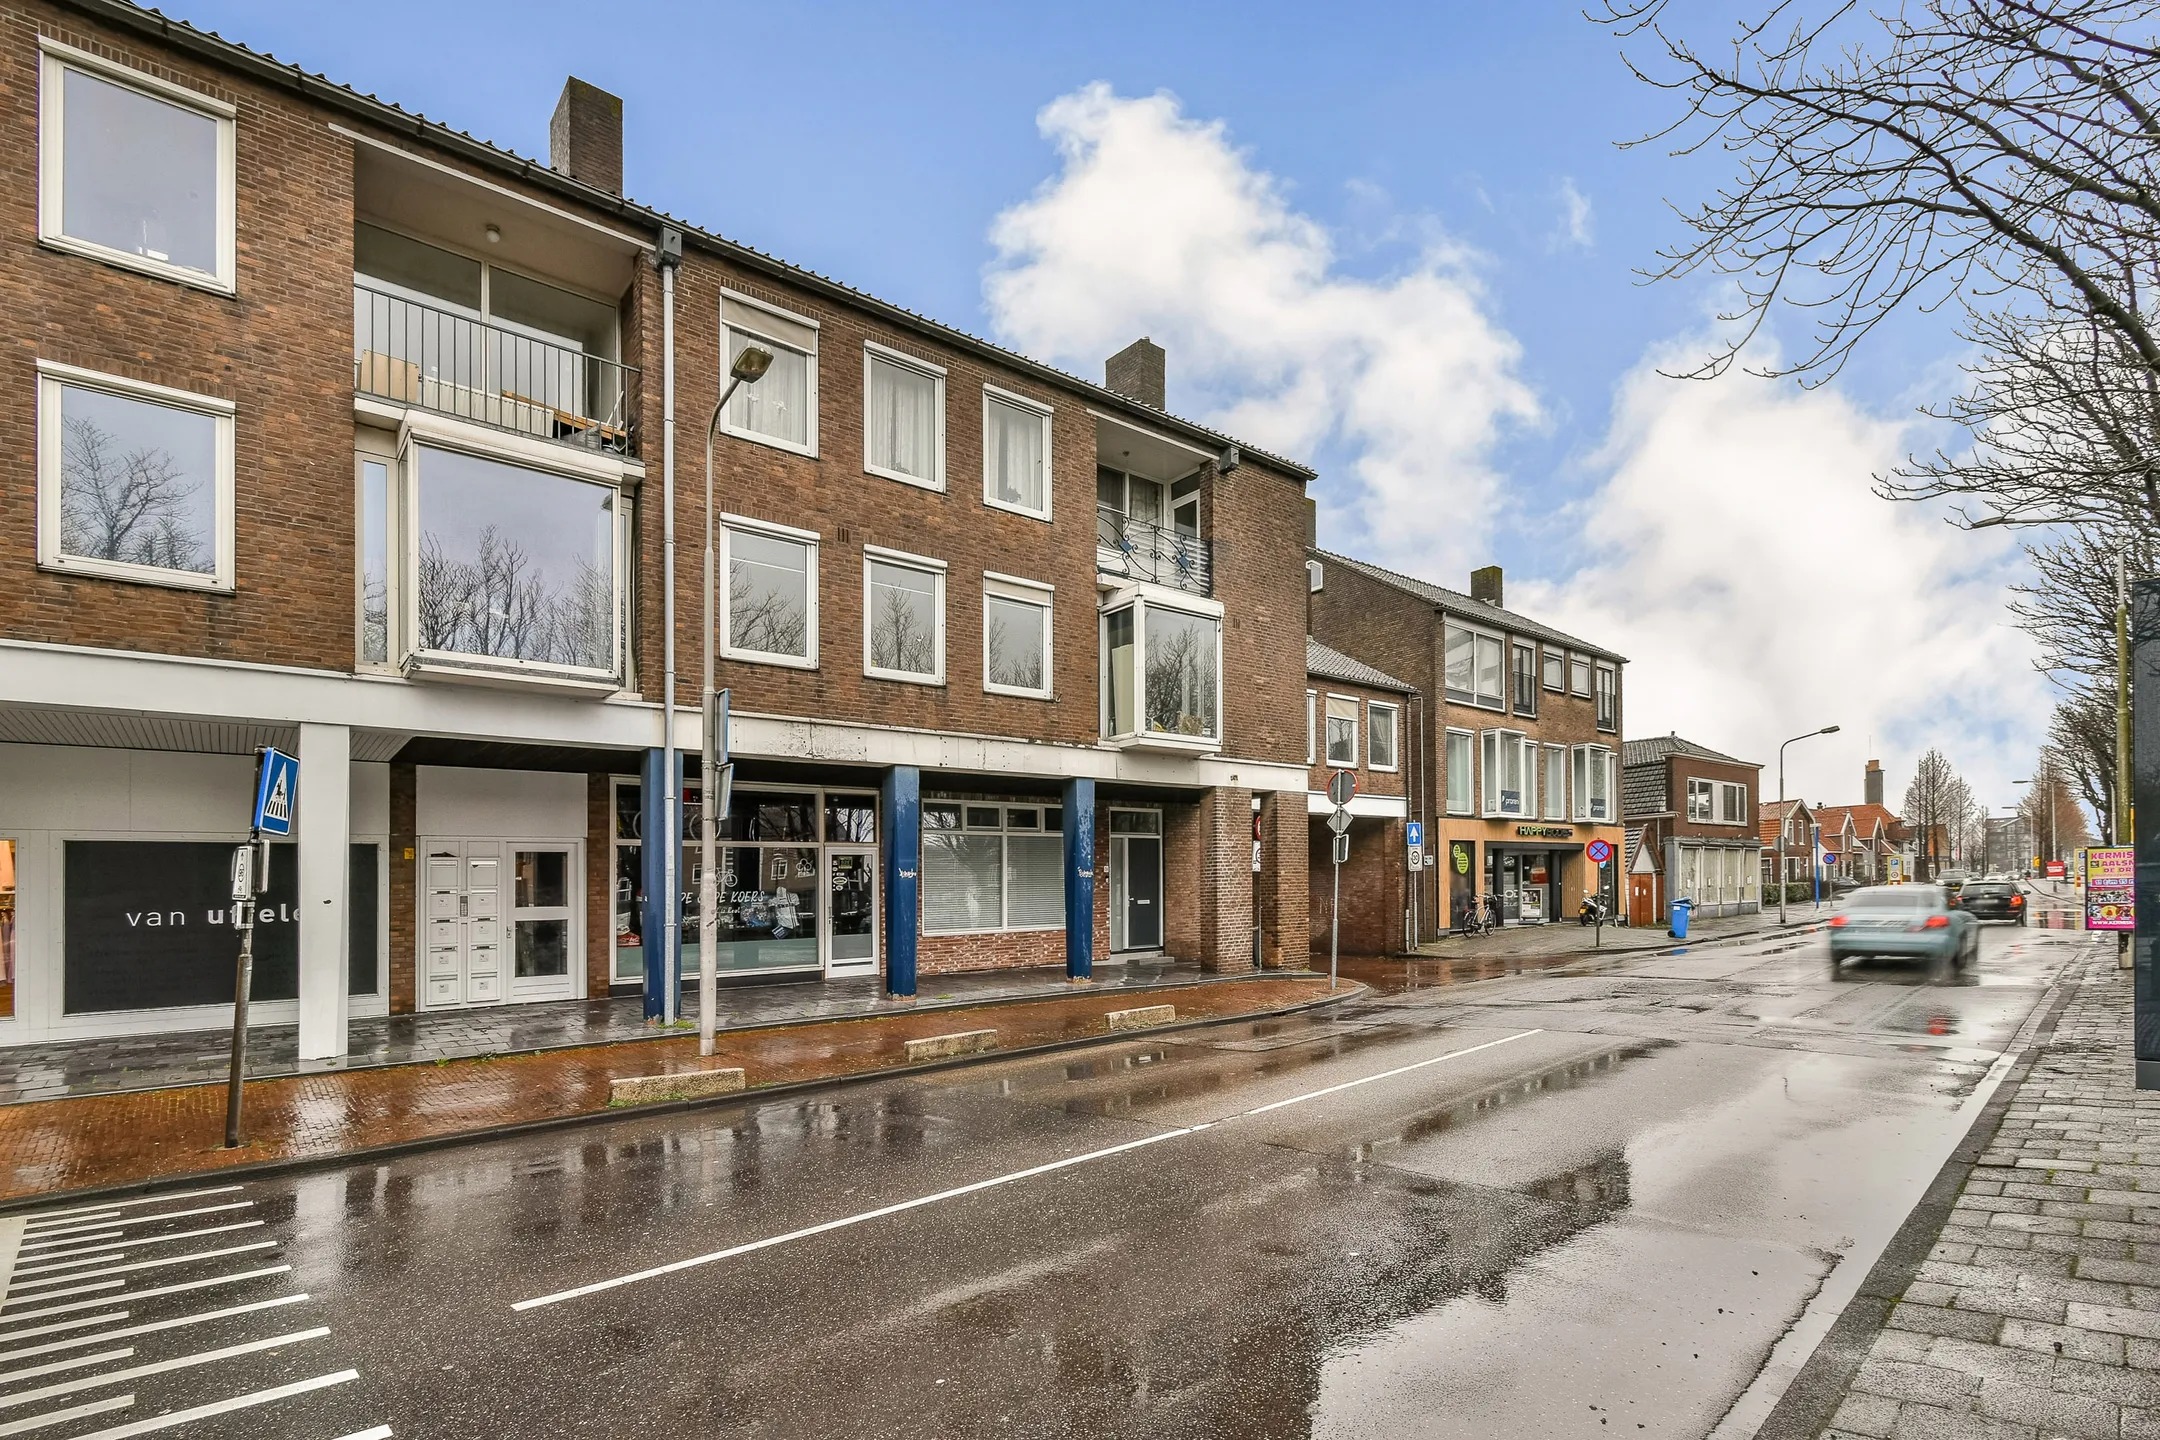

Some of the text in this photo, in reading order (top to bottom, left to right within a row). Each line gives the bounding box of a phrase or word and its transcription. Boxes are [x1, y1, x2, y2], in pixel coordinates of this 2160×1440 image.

[2091, 852, 2134, 860] KERMIS
[731, 890, 765, 903] KOERS
[126, 903, 299, 927] van ufel
